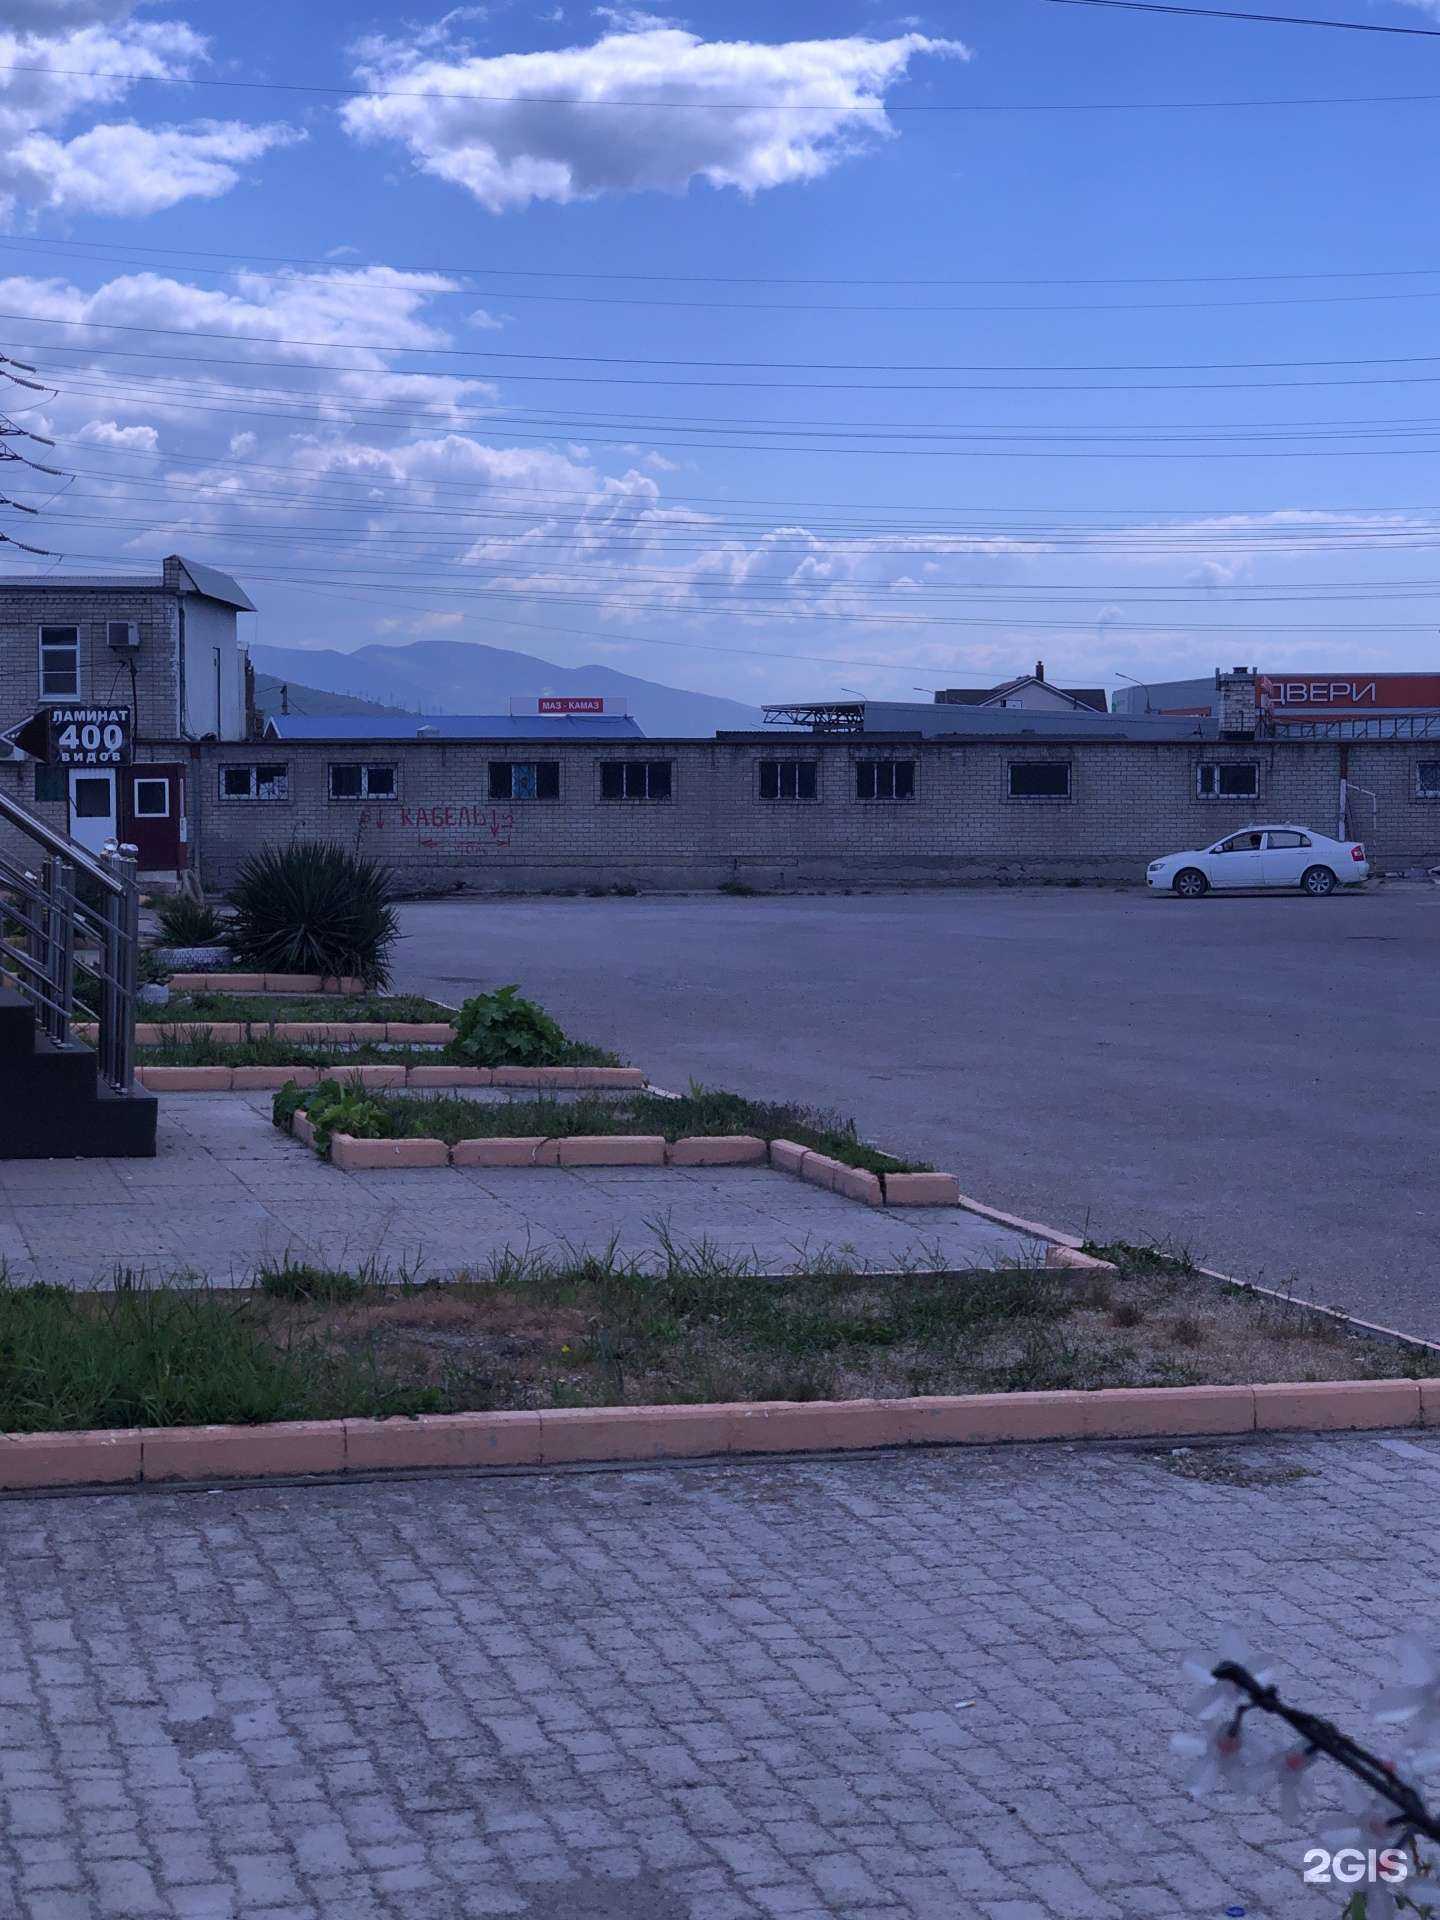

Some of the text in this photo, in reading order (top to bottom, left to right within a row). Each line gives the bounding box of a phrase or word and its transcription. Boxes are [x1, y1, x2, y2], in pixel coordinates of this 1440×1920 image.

[1269, 682, 1376, 705] ДВЕРИ
[542, 701, 561, 710] МАЗ
[568, 701, 600, 710] КАМАЗ
[52, 710, 128, 722] ЛАМИНАТ
[58, 724, 123, 751] 400
[61, 752, 121, 763] ВИДОВ
[401, 806, 486, 827] КАБЕЛЬ
